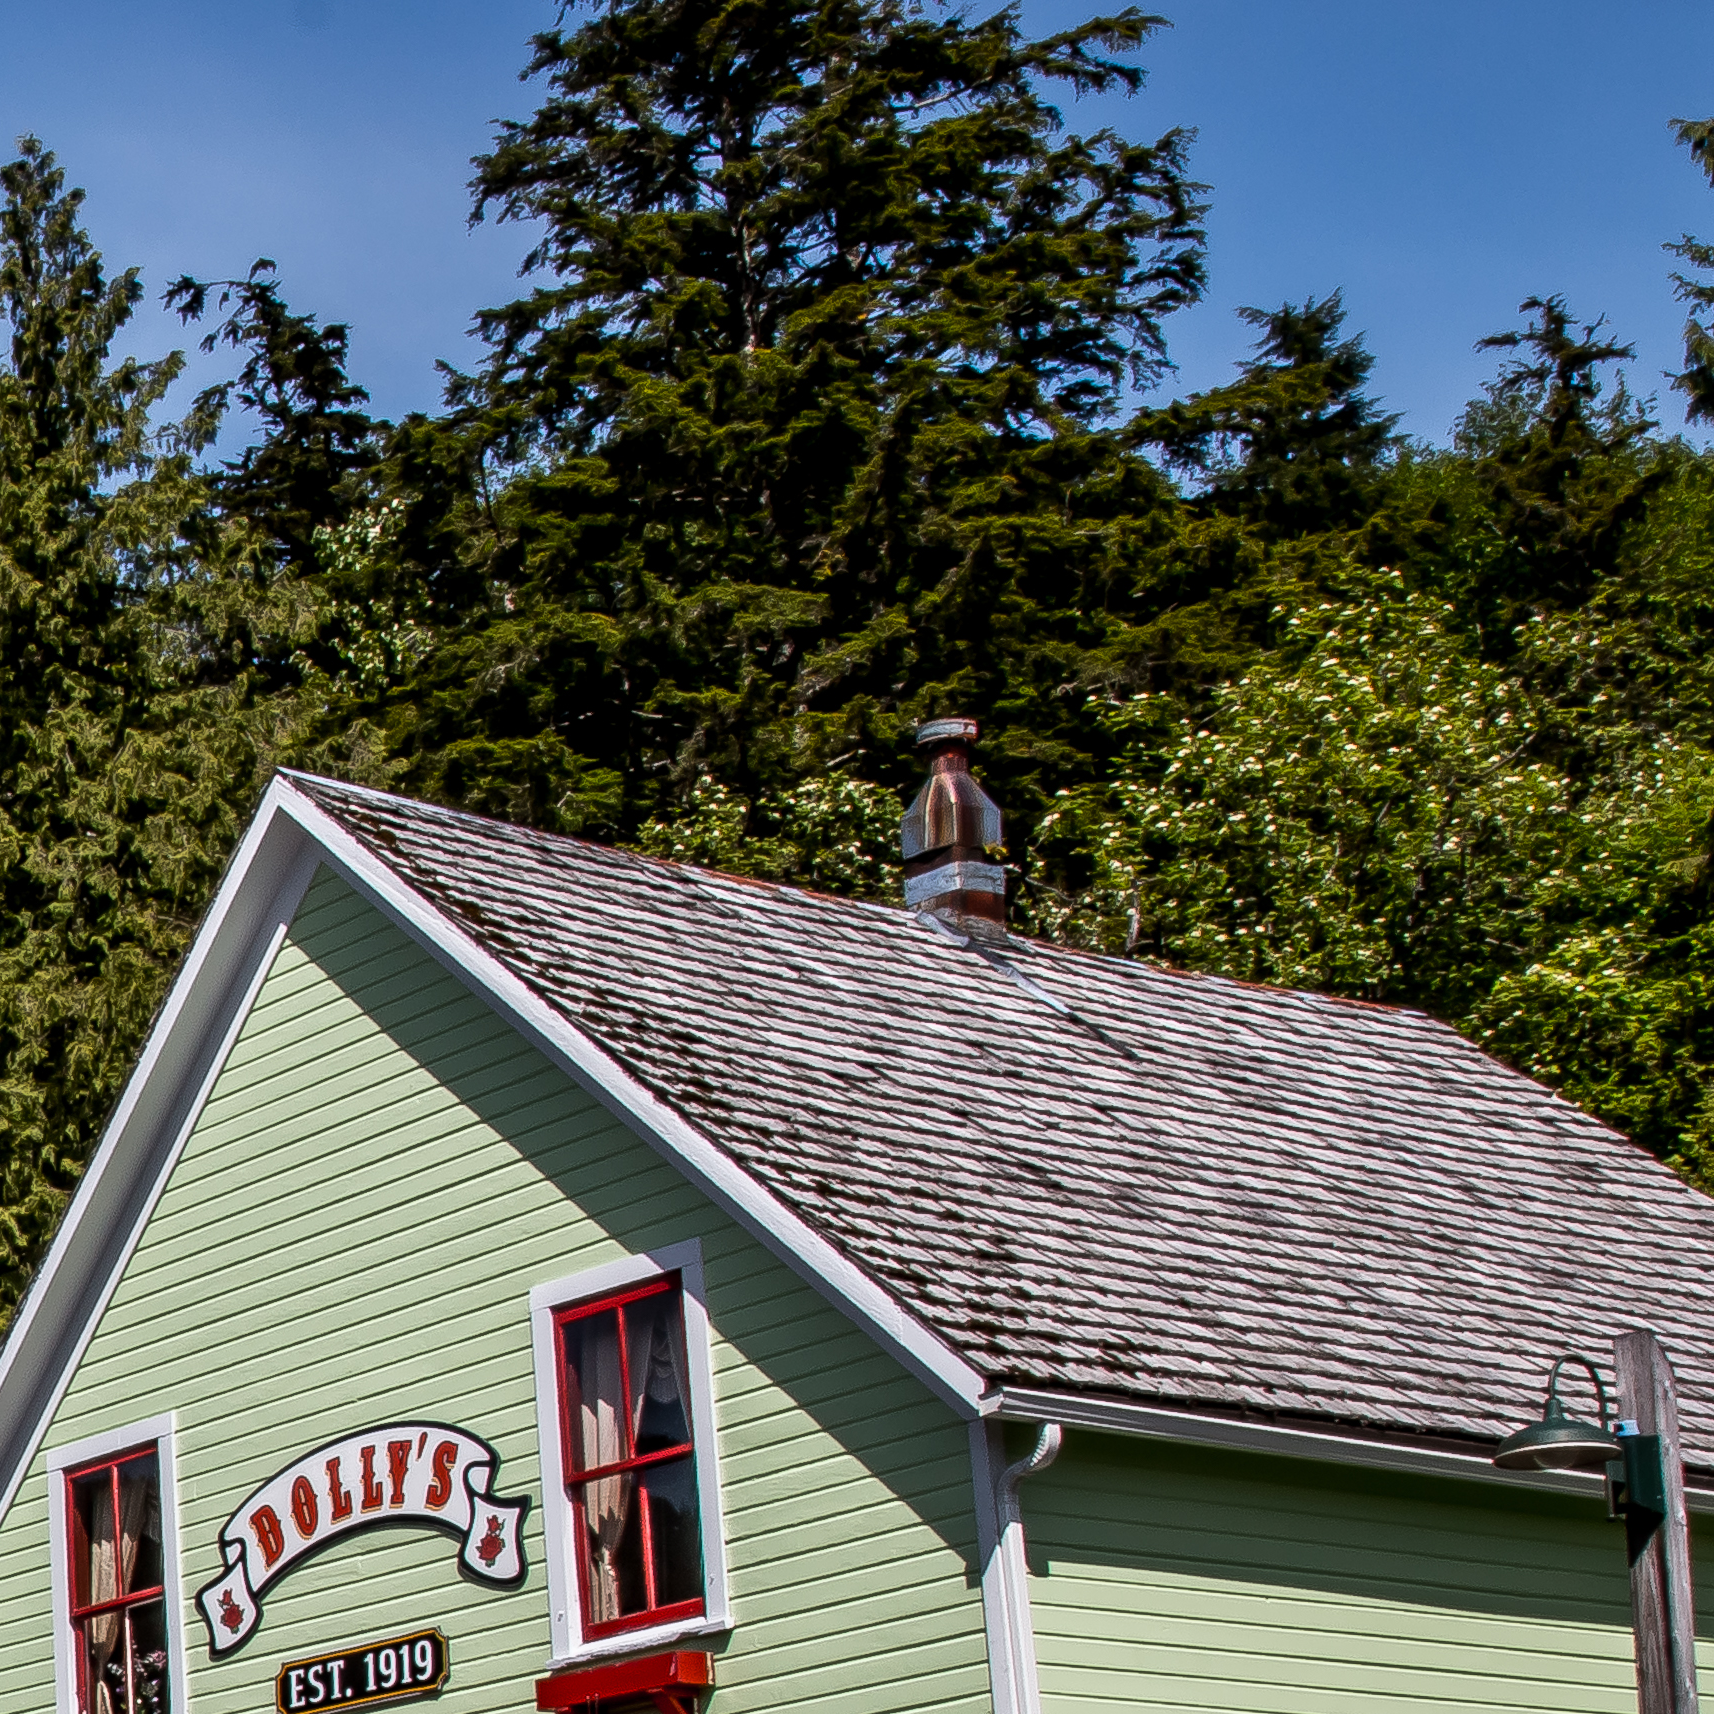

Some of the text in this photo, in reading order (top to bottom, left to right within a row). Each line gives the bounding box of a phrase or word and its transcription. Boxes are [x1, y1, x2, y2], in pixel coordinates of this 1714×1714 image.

[248, 1431, 459, 1572] DOLLY'S
[287, 1639, 434, 1708] EST. 1919
